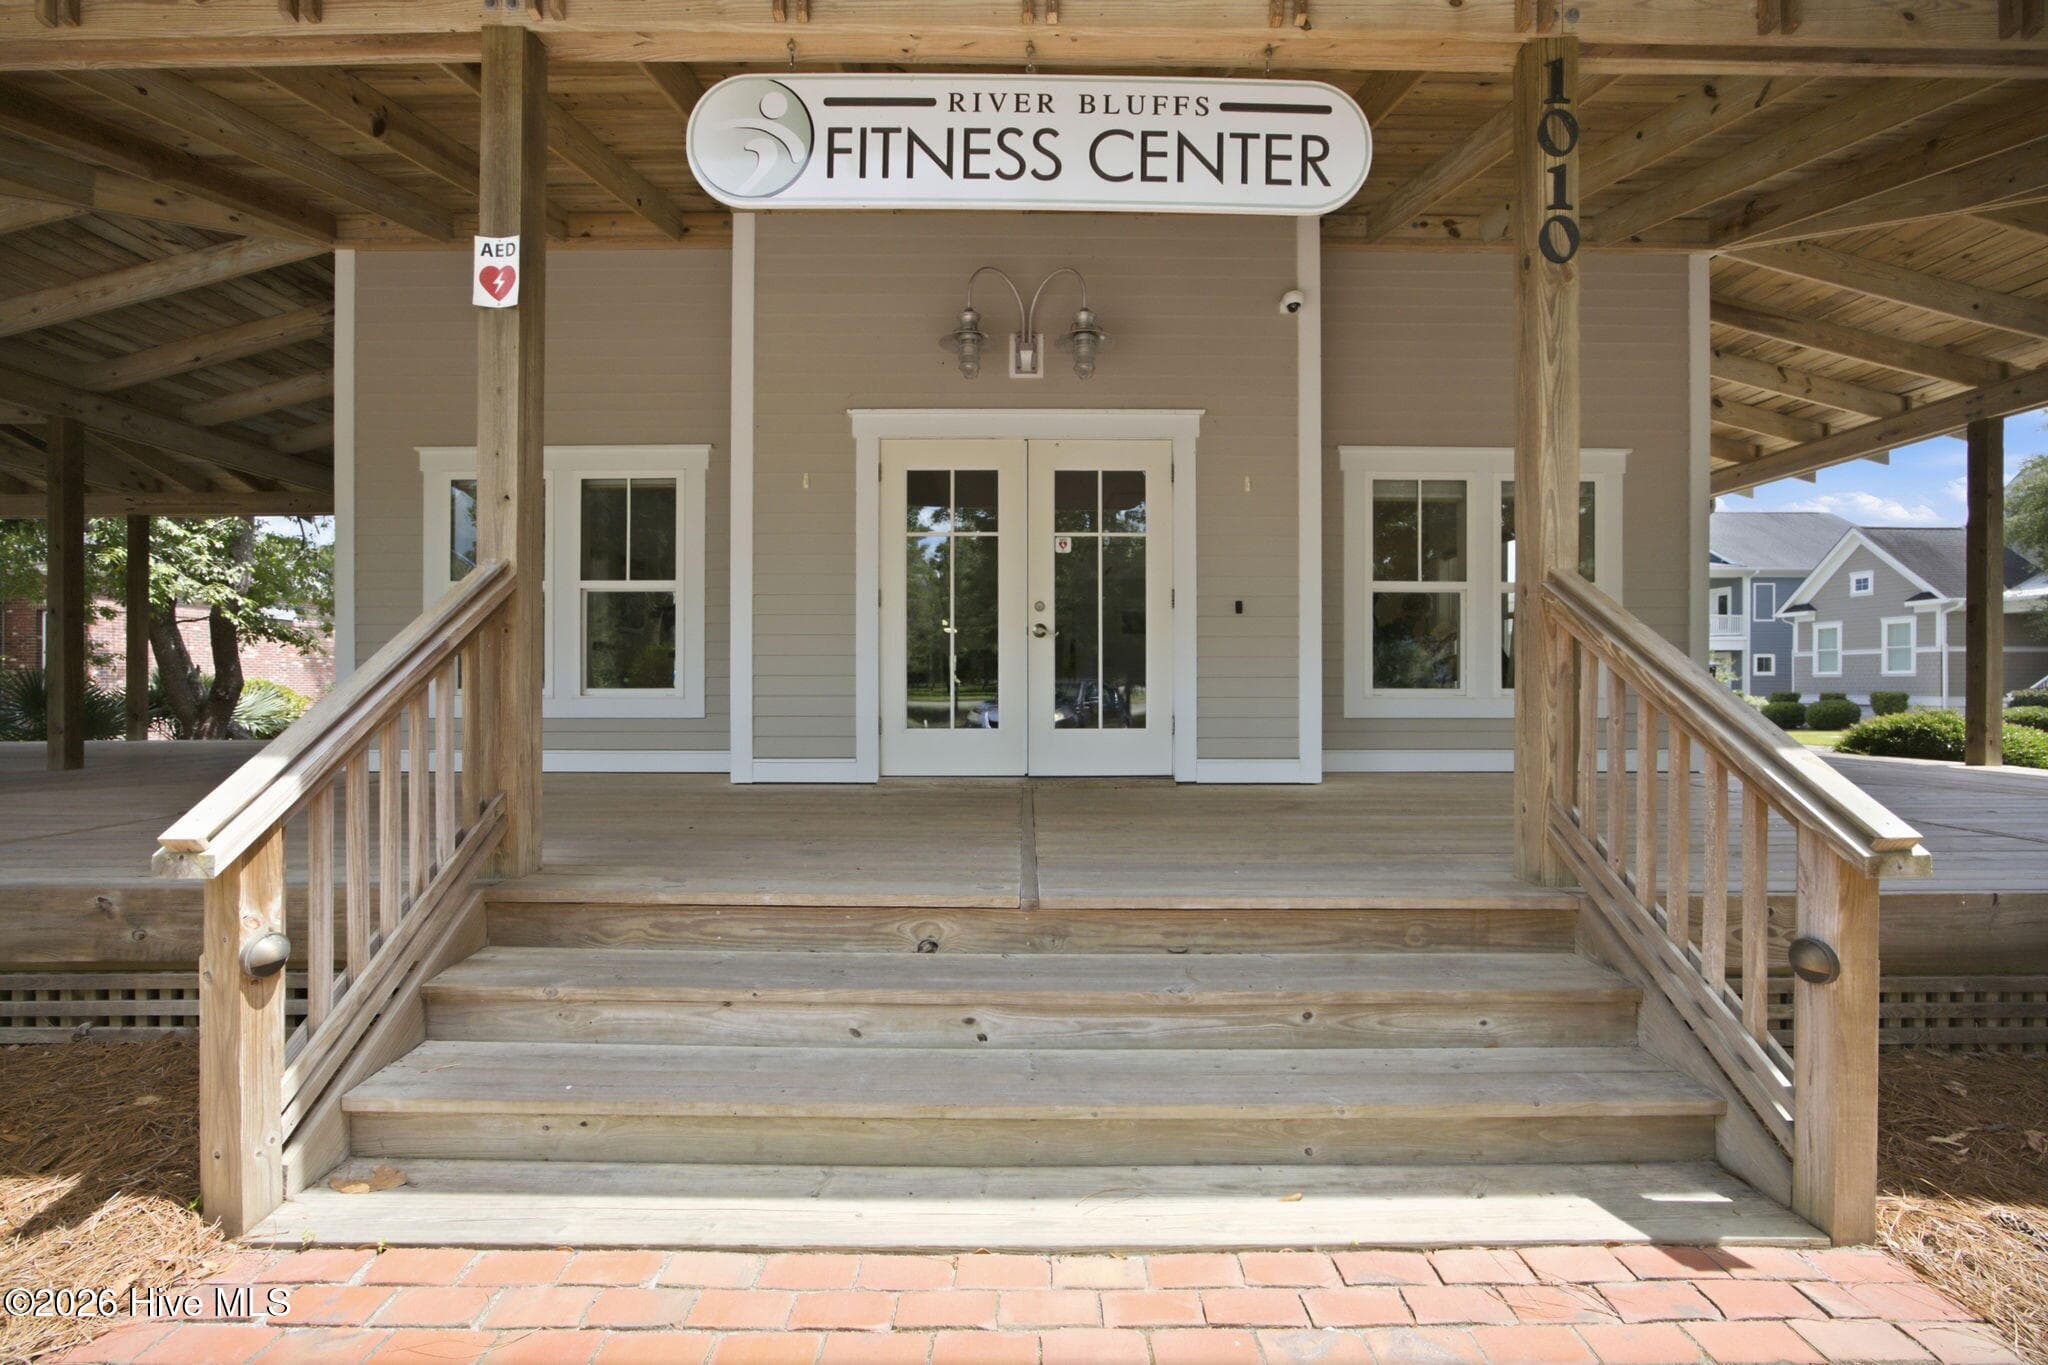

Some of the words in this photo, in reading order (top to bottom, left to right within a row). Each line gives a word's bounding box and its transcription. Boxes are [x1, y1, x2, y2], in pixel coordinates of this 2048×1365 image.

[948, 92, 1055, 114] RIVER
[1079, 94, 1210, 117] BLUFFS
[825, 127, 1062, 181] FITNESS
[1089, 129, 1331, 187] CENTER
[481, 243, 516, 257] AED
